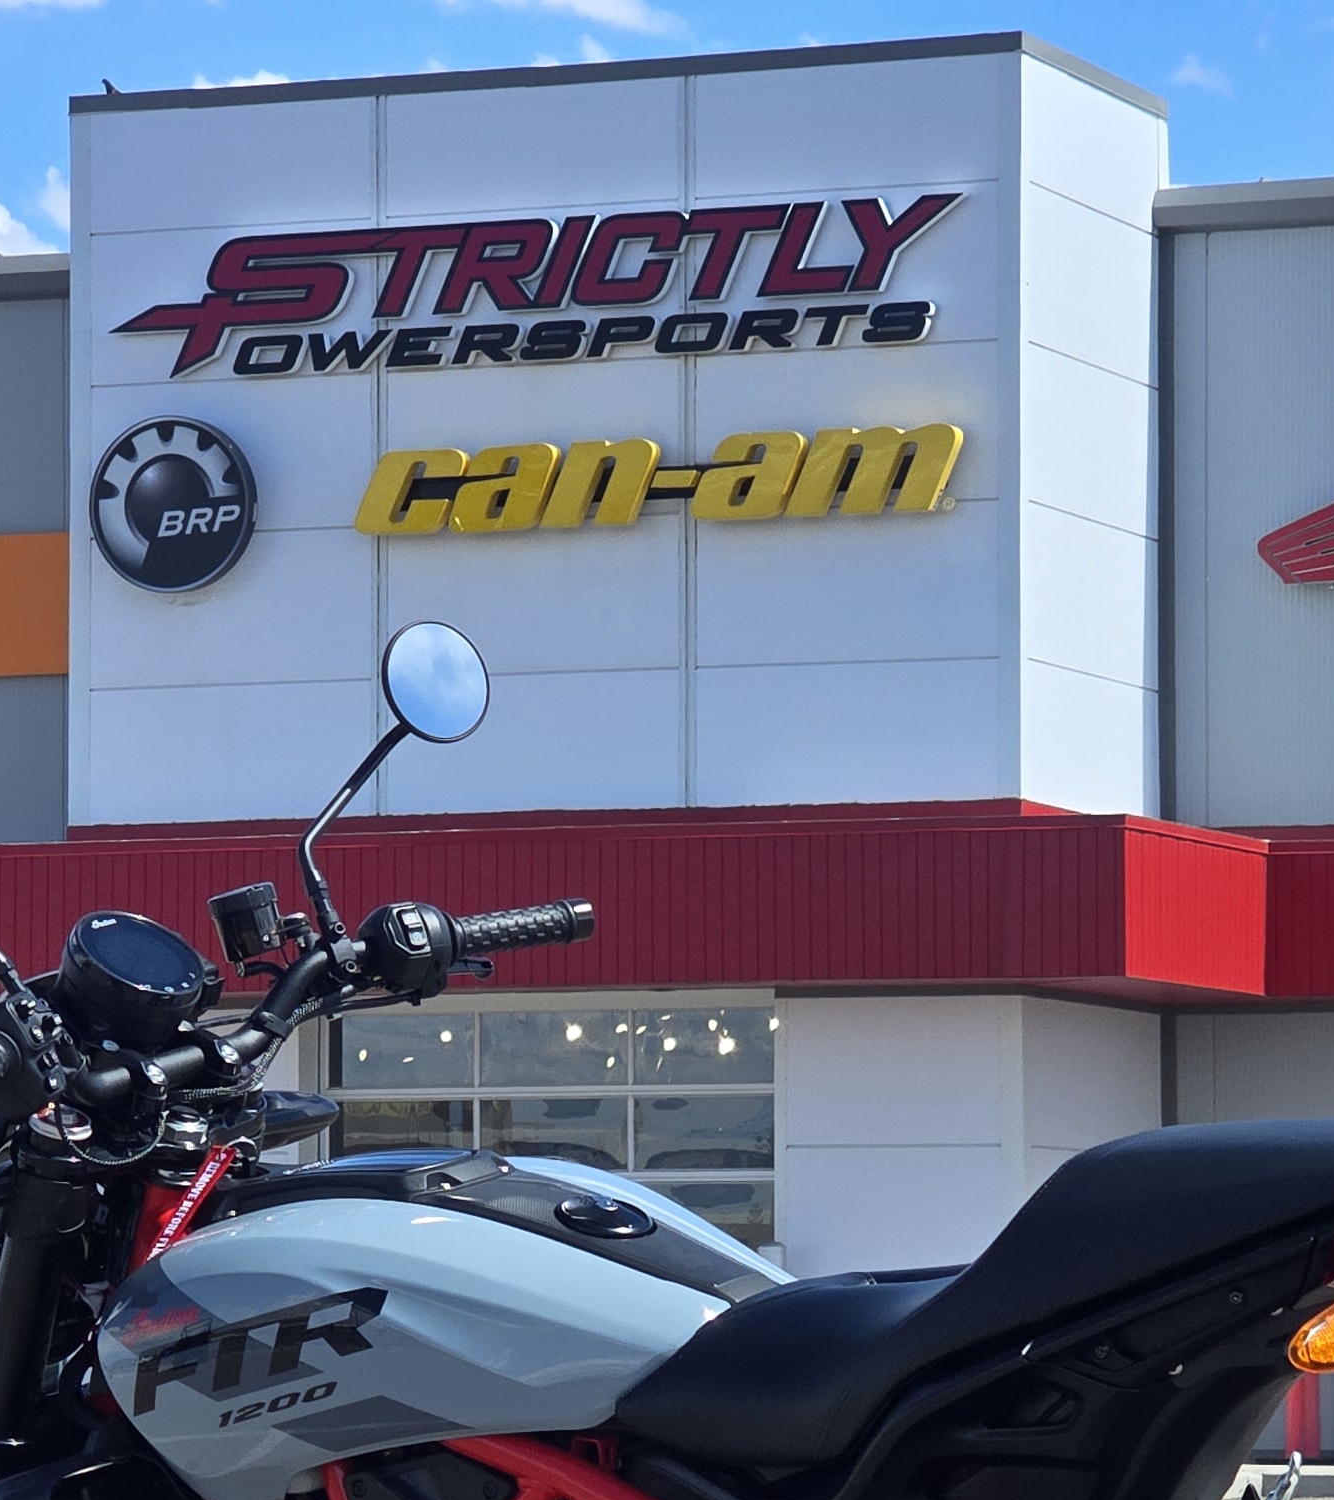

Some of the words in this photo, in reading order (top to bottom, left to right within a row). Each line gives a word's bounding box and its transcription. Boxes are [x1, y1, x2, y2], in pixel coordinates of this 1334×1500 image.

[108, 192, 965, 334] STRICTLY
[157, 504, 241, 538] BRP
[354, 422, 966, 536] can-am
[132, 1286, 389, 1418] FTR
[218, 1381, 338, 1429] 1200
